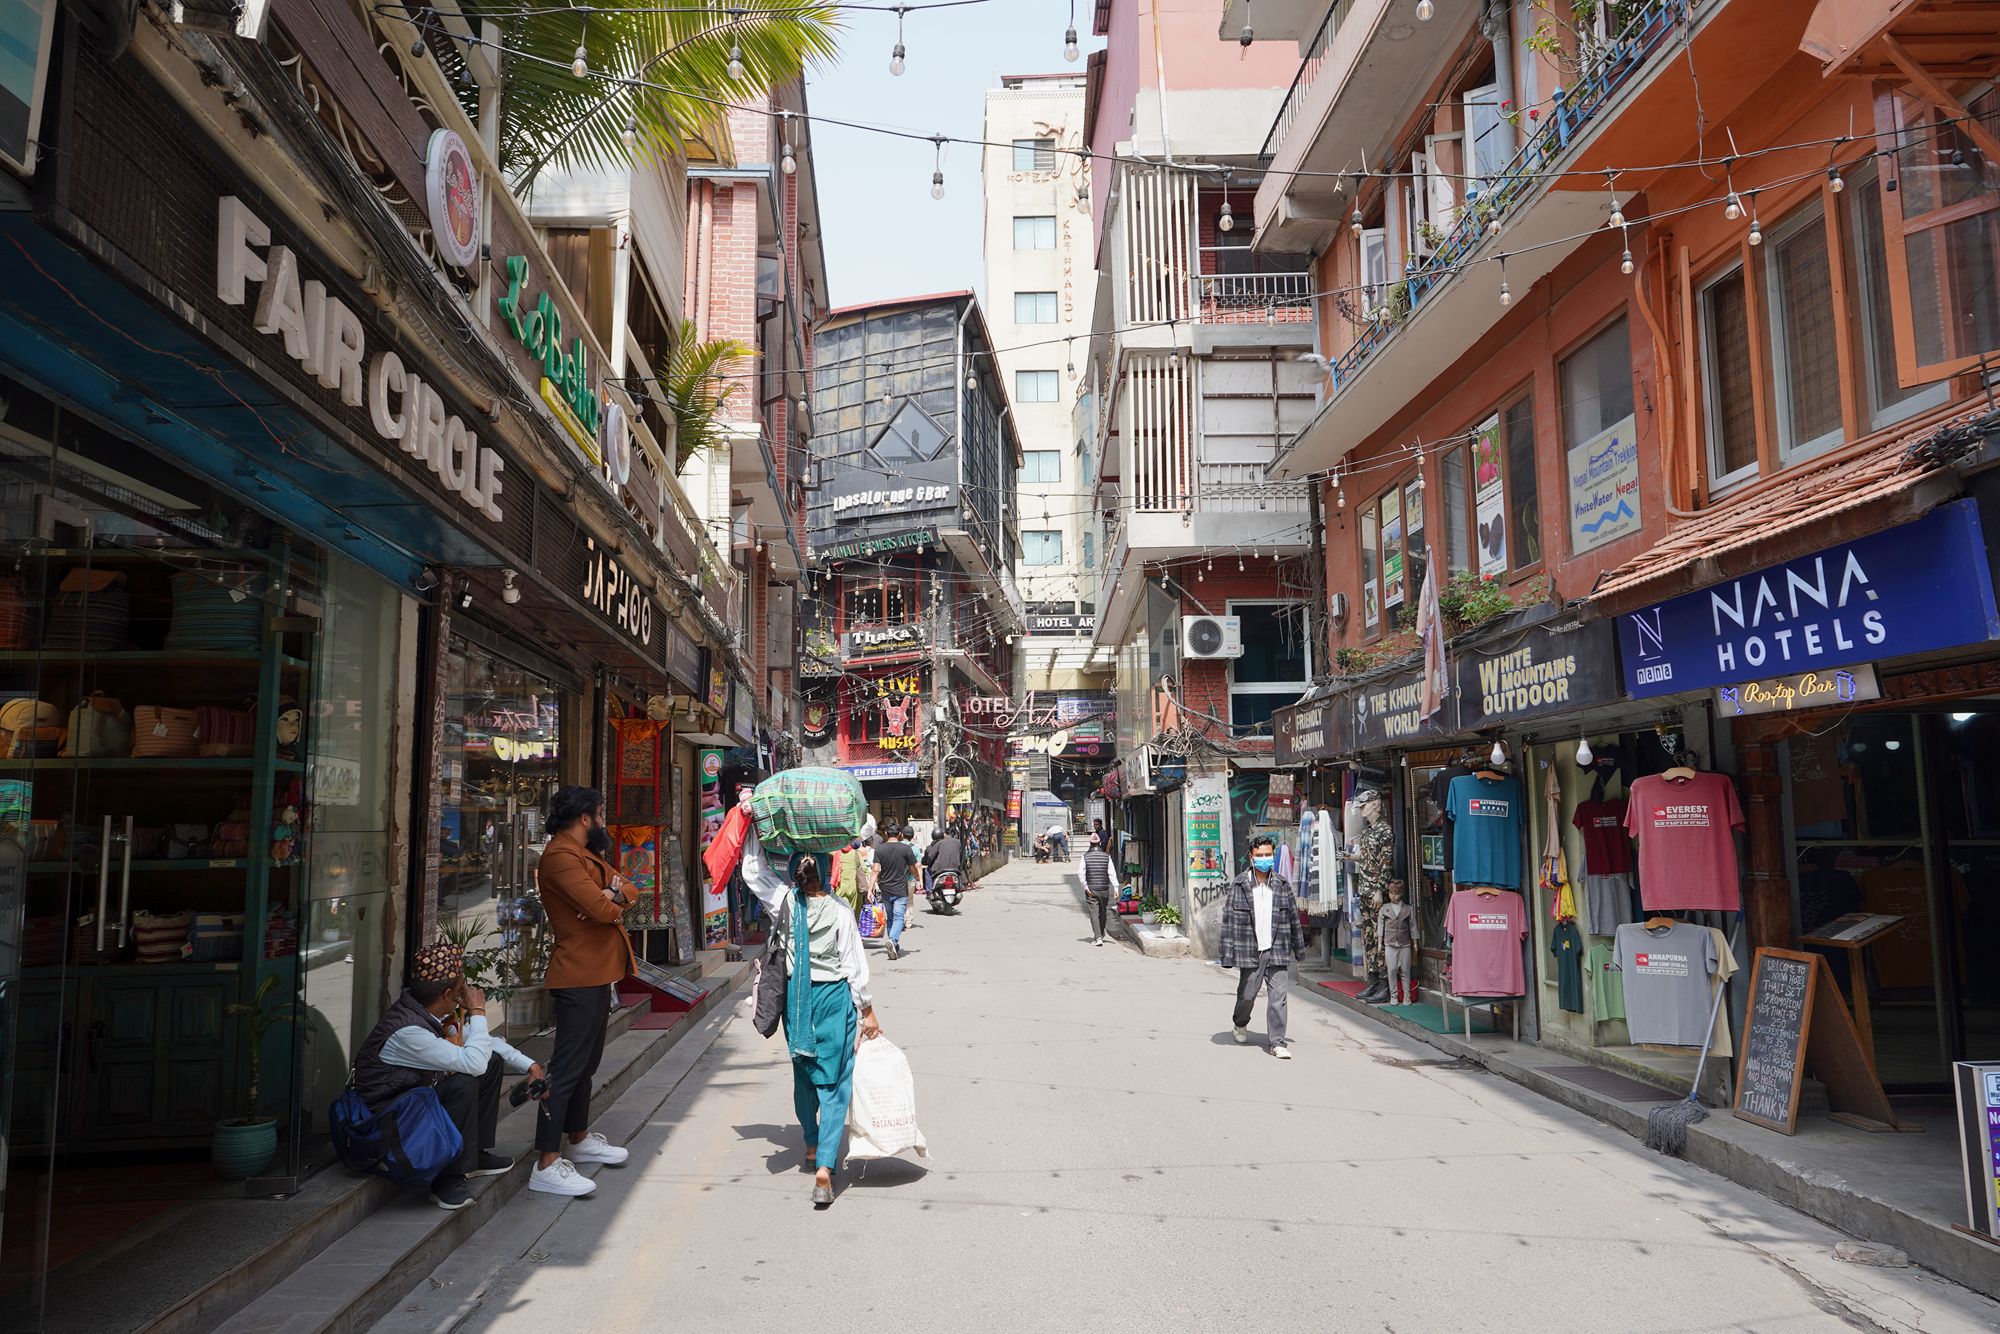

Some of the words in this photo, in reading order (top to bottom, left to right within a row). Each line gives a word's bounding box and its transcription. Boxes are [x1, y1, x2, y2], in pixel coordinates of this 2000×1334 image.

[217, 195, 364, 406] FAIR
[369, 351, 504, 522] CIRCLE
[1573, 470, 1588, 489] Nepal
[1588, 457, 1614, 481] Mountain
[925, 485, 950, 501] Bar
[1574, 490, 1614, 519] WhiteWater
[1615, 476, 1638, 499] Nepal
[859, 536, 897, 555] FRMERS
[1710, 549, 1879, 636] NANA
[1036, 617, 1072, 628] HOTEL
[1630, 607, 1665, 657] N
[852, 625, 924, 646] Thakai
[1716, 610, 1886, 672] HOTELS
[1479, 646, 1532, 696] WHITE
[1501, 655, 1577, 692] MOUNTAINS
[1636, 662, 1672, 685] nana
[877, 676, 920, 697] LIVE
[1799, 672, 1837, 697] Bar
[961, 696, 1015, 714] HOTEL
[1370, 692, 1387, 716] THE
[1389, 680, 1425, 711] KHUKU
[1483, 677, 1570, 716] OUTDOOR
[1296, 708, 1323, 731] FRIENDLY
[1384, 710, 1420, 738] WORLD
[878, 735, 917, 750] MUSIC
[1291, 730, 1325, 753] PASHMINA
[853, 765, 915, 777] ENTERPRISES
[1666, 805, 1708, 813] EVEREST
[1200, 831, 1209, 839] &
[1648, 953, 1688, 962] ANNAPURNA
[1767, 960, 1796, 974] WELCOME
[1797, 965, 1806, 975] TO
[1763, 980, 1785, 994] THALI
[1785, 986, 1804, 997] SET
[1788, 975, 1806, 988] HOTEL
[1764, 993, 1803, 1011] PROMOTION
[1771, 1017, 1787, 1029] 250
[1775, 1038, 1788, 1050] 350
[1760, 1074, 1777, 1088] HOTEL
[1745, 1091, 1778, 1119] THANK
[1774, 1088, 1788, 1103] THU
